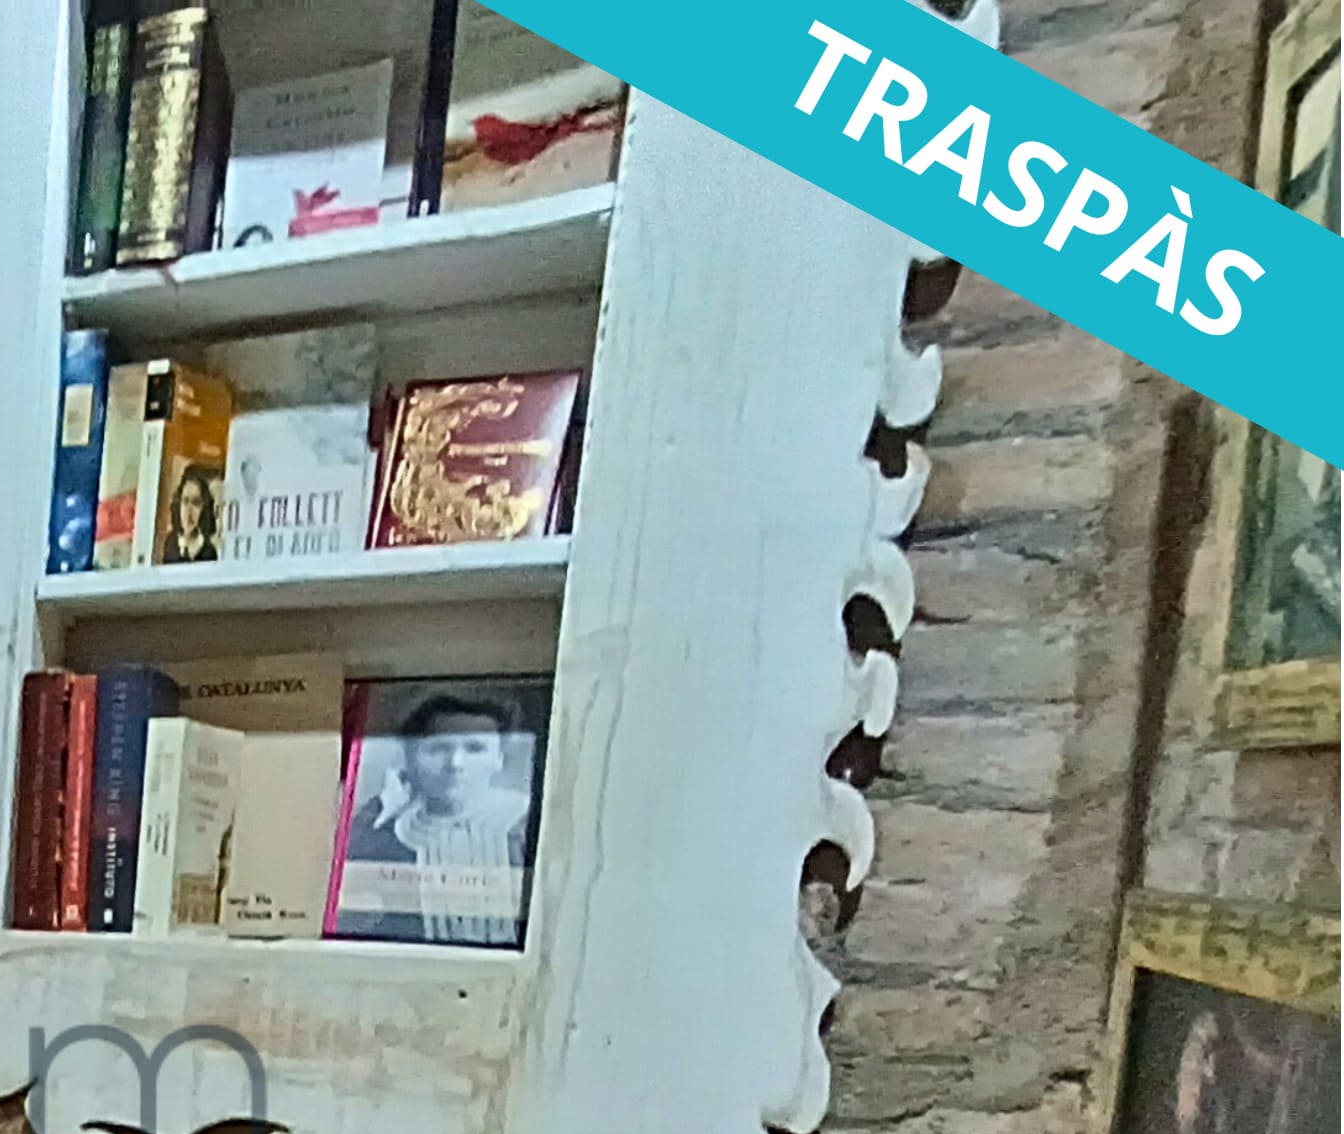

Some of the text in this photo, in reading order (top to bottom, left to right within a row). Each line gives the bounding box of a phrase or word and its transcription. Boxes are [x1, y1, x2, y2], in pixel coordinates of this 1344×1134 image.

[257, 489, 343, 529] FOLLETT
[197, 678, 306, 698] CATALUNYA
[107, 767, 123, 816] KING
